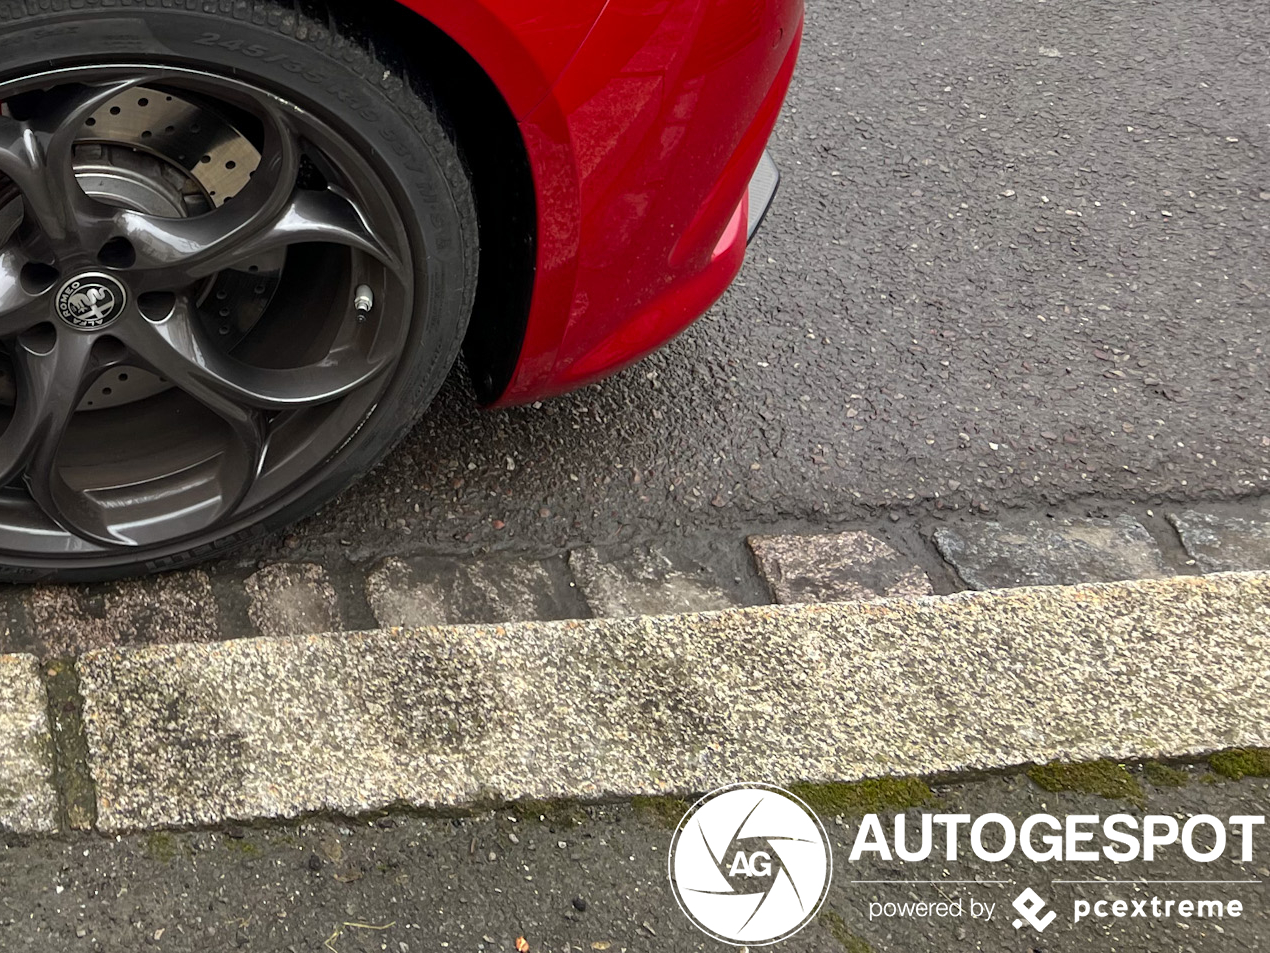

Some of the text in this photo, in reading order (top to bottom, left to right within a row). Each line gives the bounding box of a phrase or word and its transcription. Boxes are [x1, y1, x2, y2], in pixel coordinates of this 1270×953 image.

[194, 32, 327, 84] 245/35
[60, 281, 104, 326] ALFA ROMEO
